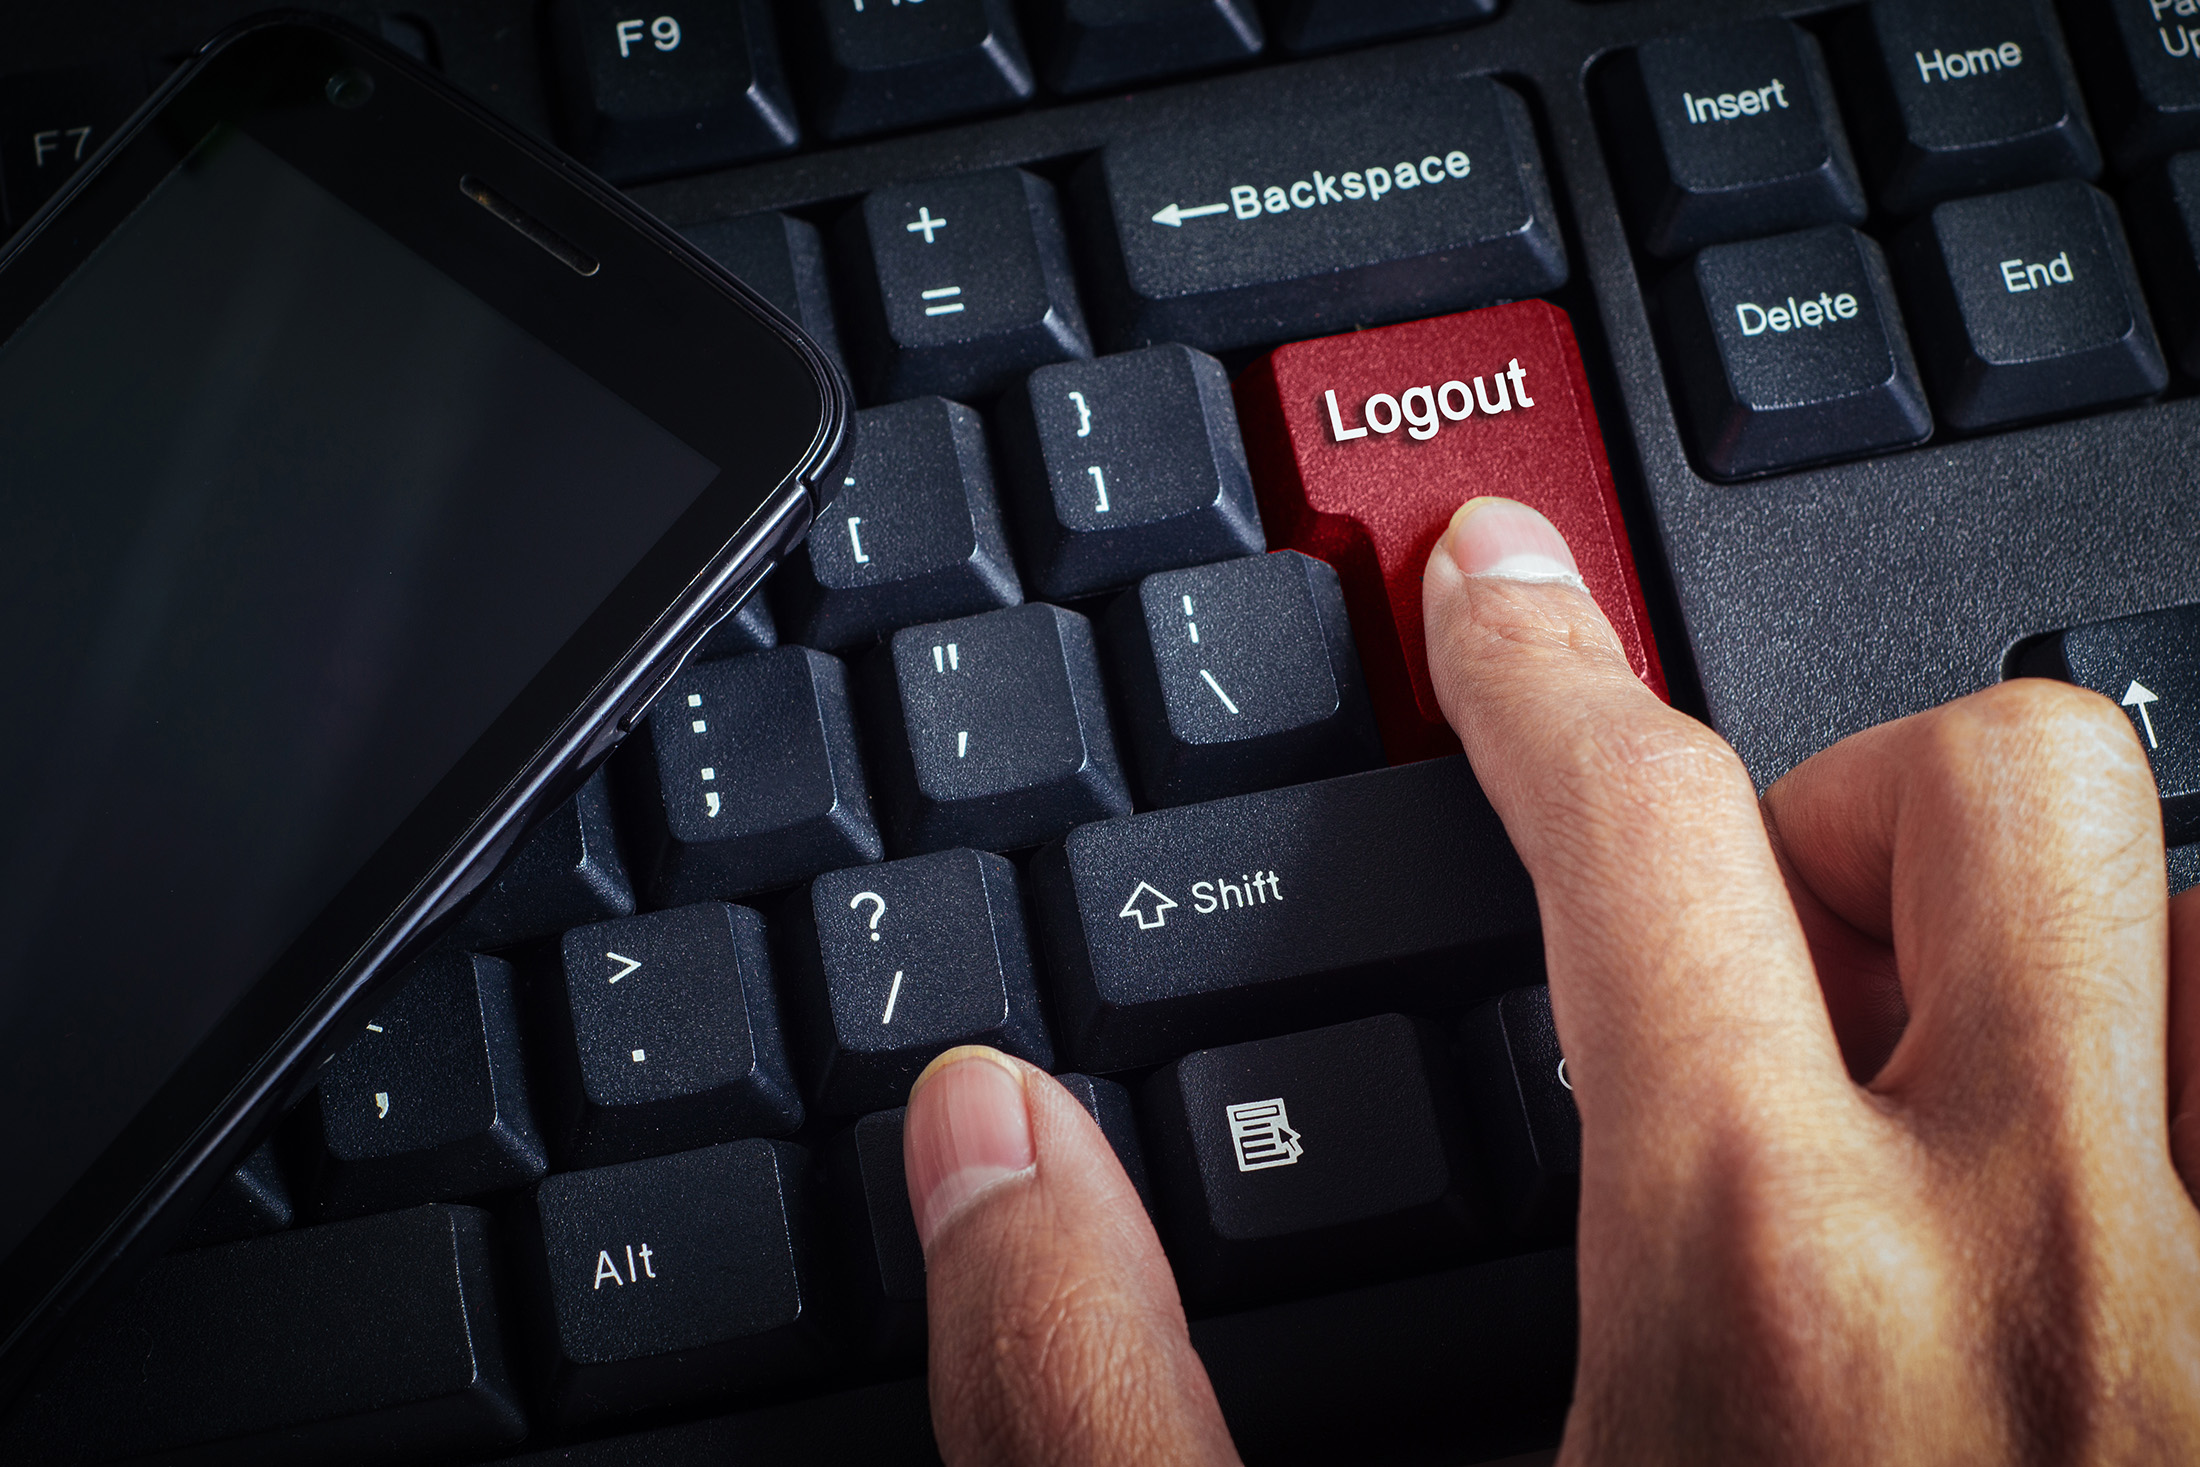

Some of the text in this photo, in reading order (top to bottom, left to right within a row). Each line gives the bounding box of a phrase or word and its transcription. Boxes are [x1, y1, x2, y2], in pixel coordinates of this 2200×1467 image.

[2149, 0, 2200, 21] Pa
[616, 16, 681, 58] F9
[1915, 38, 2022, 83] Home
[1683, 78, 1789, 124] Insert
[33, 126, 92, 167] F7
[1230, 150, 1472, 220] Backspace
[906, 207, 947, 243] +
[2000, 251, 2074, 293] End
[921, 286, 965, 316] =
[1735, 291, 1858, 336] Delete
[1068, 391, 1091, 437] }
[1324, 357, 1535, 442] Logout
[1087, 466, 1110, 513] ]
[847, 516, 869, 563] [
[687, 693, 707, 734] :
[1199, 669, 1240, 715] \
[700, 767, 720, 818] ;
[1191, 870, 1284, 914] Shift
[849, 891, 886, 942] ?
[606, 951, 642, 985] >
[881, 970, 904, 1025] /
[593, 1242, 657, 1290] Alt
